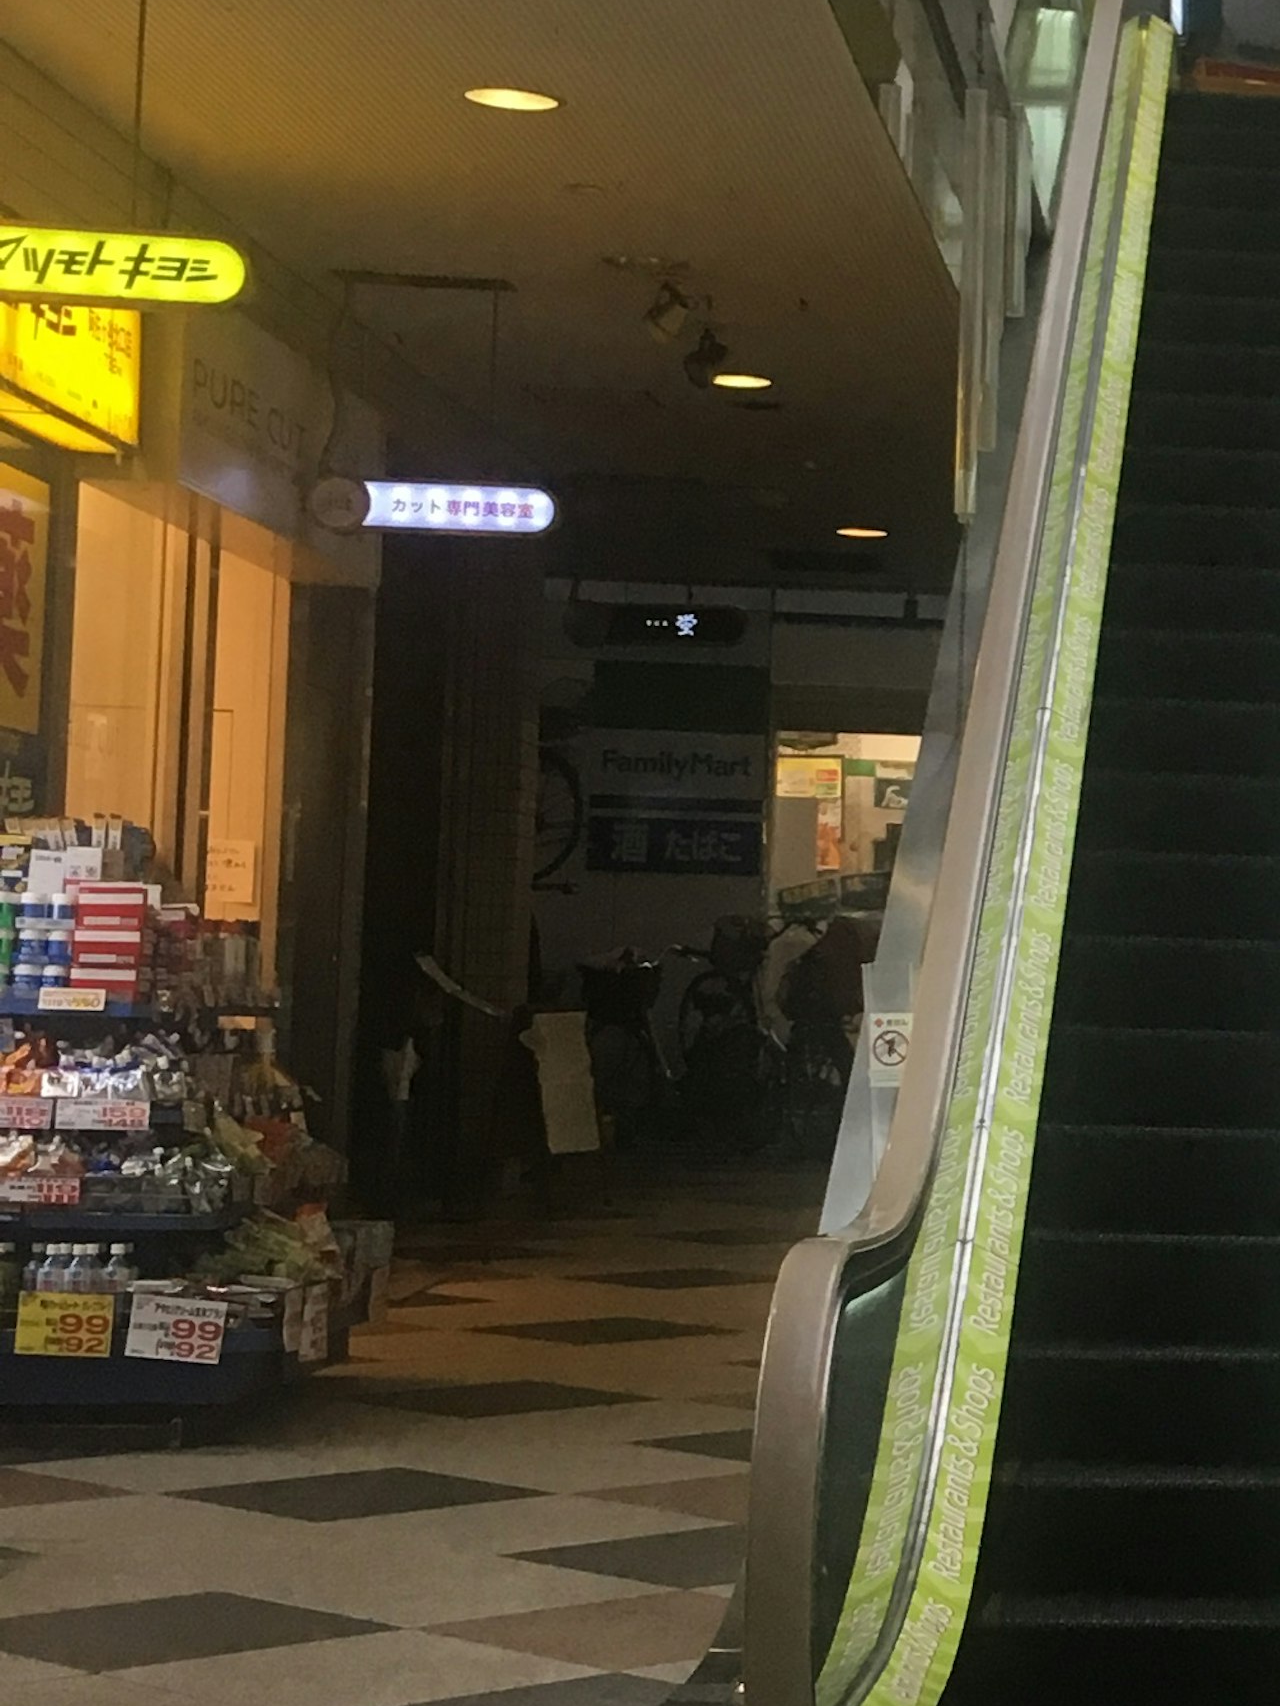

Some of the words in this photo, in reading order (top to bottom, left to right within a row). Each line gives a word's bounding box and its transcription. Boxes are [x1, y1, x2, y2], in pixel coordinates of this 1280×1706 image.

[392, 498, 534, 519] カット専門美容室
[603, 749, 752, 780] FamilyMart
[666, 832, 741, 861] たばこ
[989, 1127, 1025, 1190] Shops
[970, 1205, 1016, 1335] Restaurants
[59, 1313, 110, 1335] 99
[171, 1318, 222, 1342] 99
[63, 1337, 105, 1354] 92
[174, 1341, 216, 1360] 92
[950, 1363, 995, 1437] Shops
[927, 1454, 975, 1583] Restaurants
